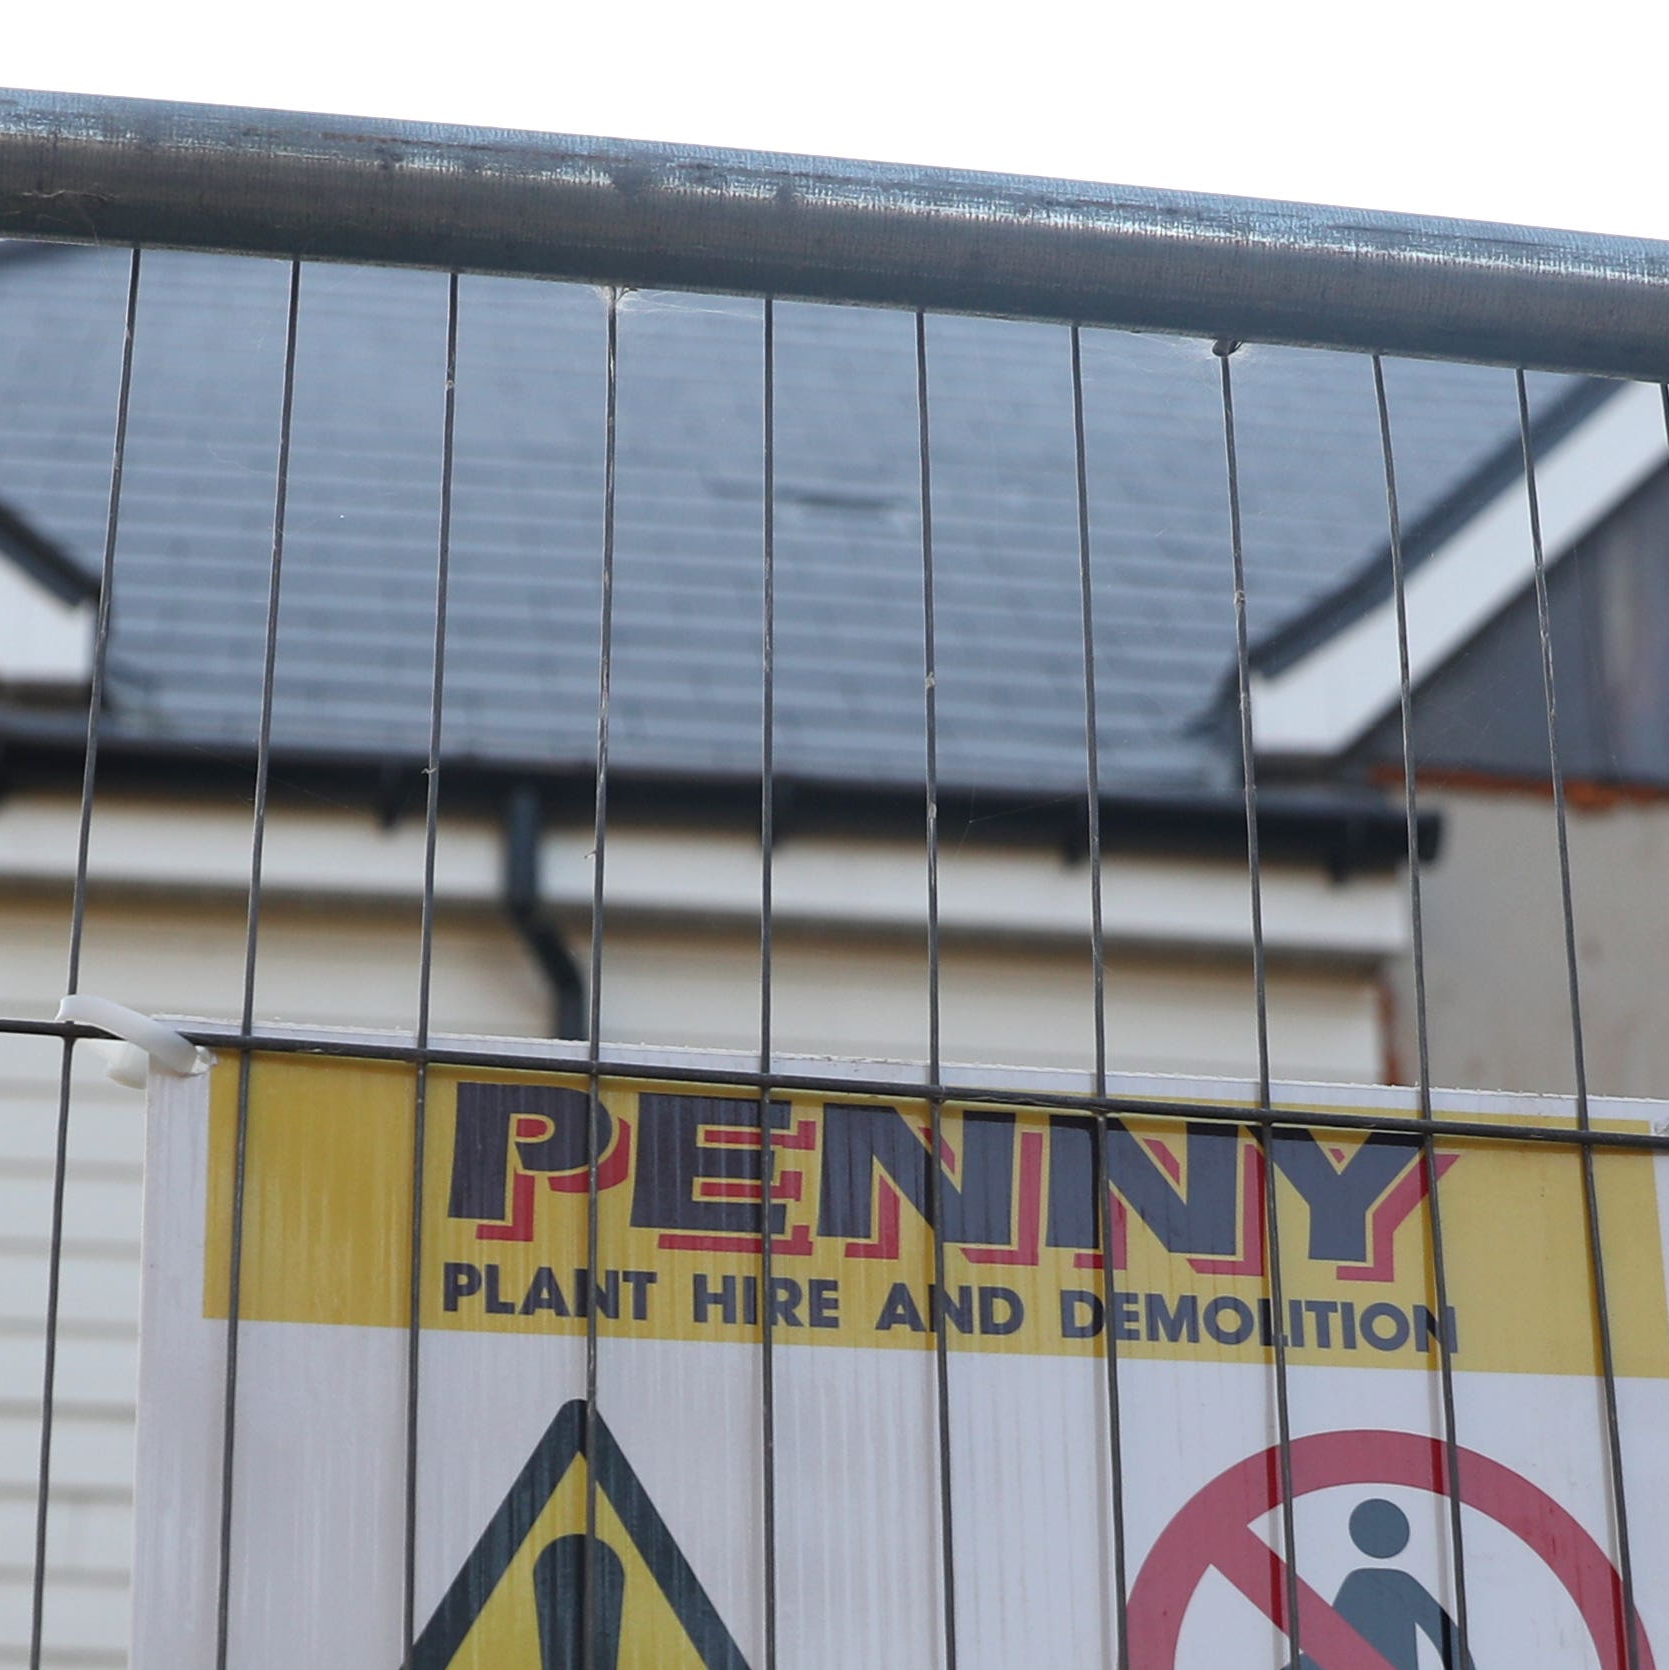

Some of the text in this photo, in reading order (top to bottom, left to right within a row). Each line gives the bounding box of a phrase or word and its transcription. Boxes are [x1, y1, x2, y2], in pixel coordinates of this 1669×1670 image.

[446, 1080, 1461, 1281] PENNY
[442, 1262, 1458, 1355] PLANT HIRE AND DEMOLITION
